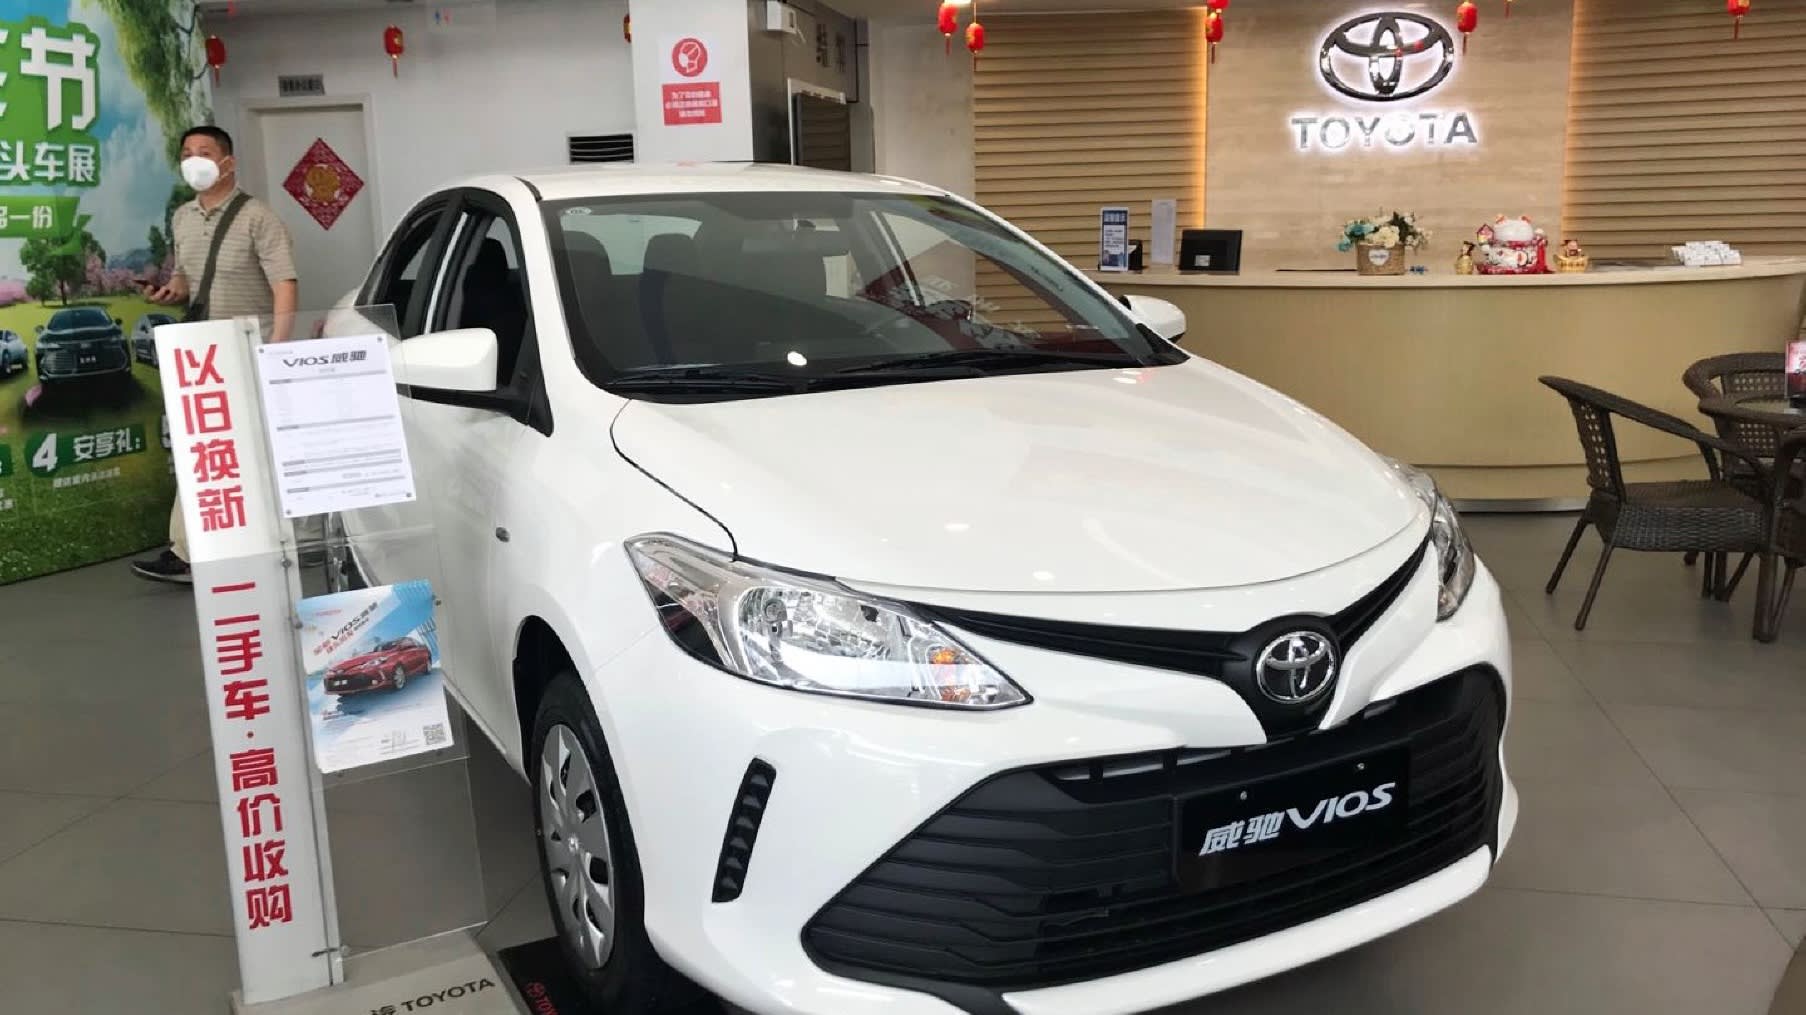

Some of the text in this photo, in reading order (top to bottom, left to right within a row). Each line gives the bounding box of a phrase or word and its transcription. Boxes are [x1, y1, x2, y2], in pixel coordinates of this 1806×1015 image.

[0, 27, 96, 130] 节
[1291, 112, 1478, 149] TOYOTA
[32, 433, 59, 472] 4
[174, 344, 247, 532] 以旧换新
[401, 978, 496, 1012] TOYOTA
